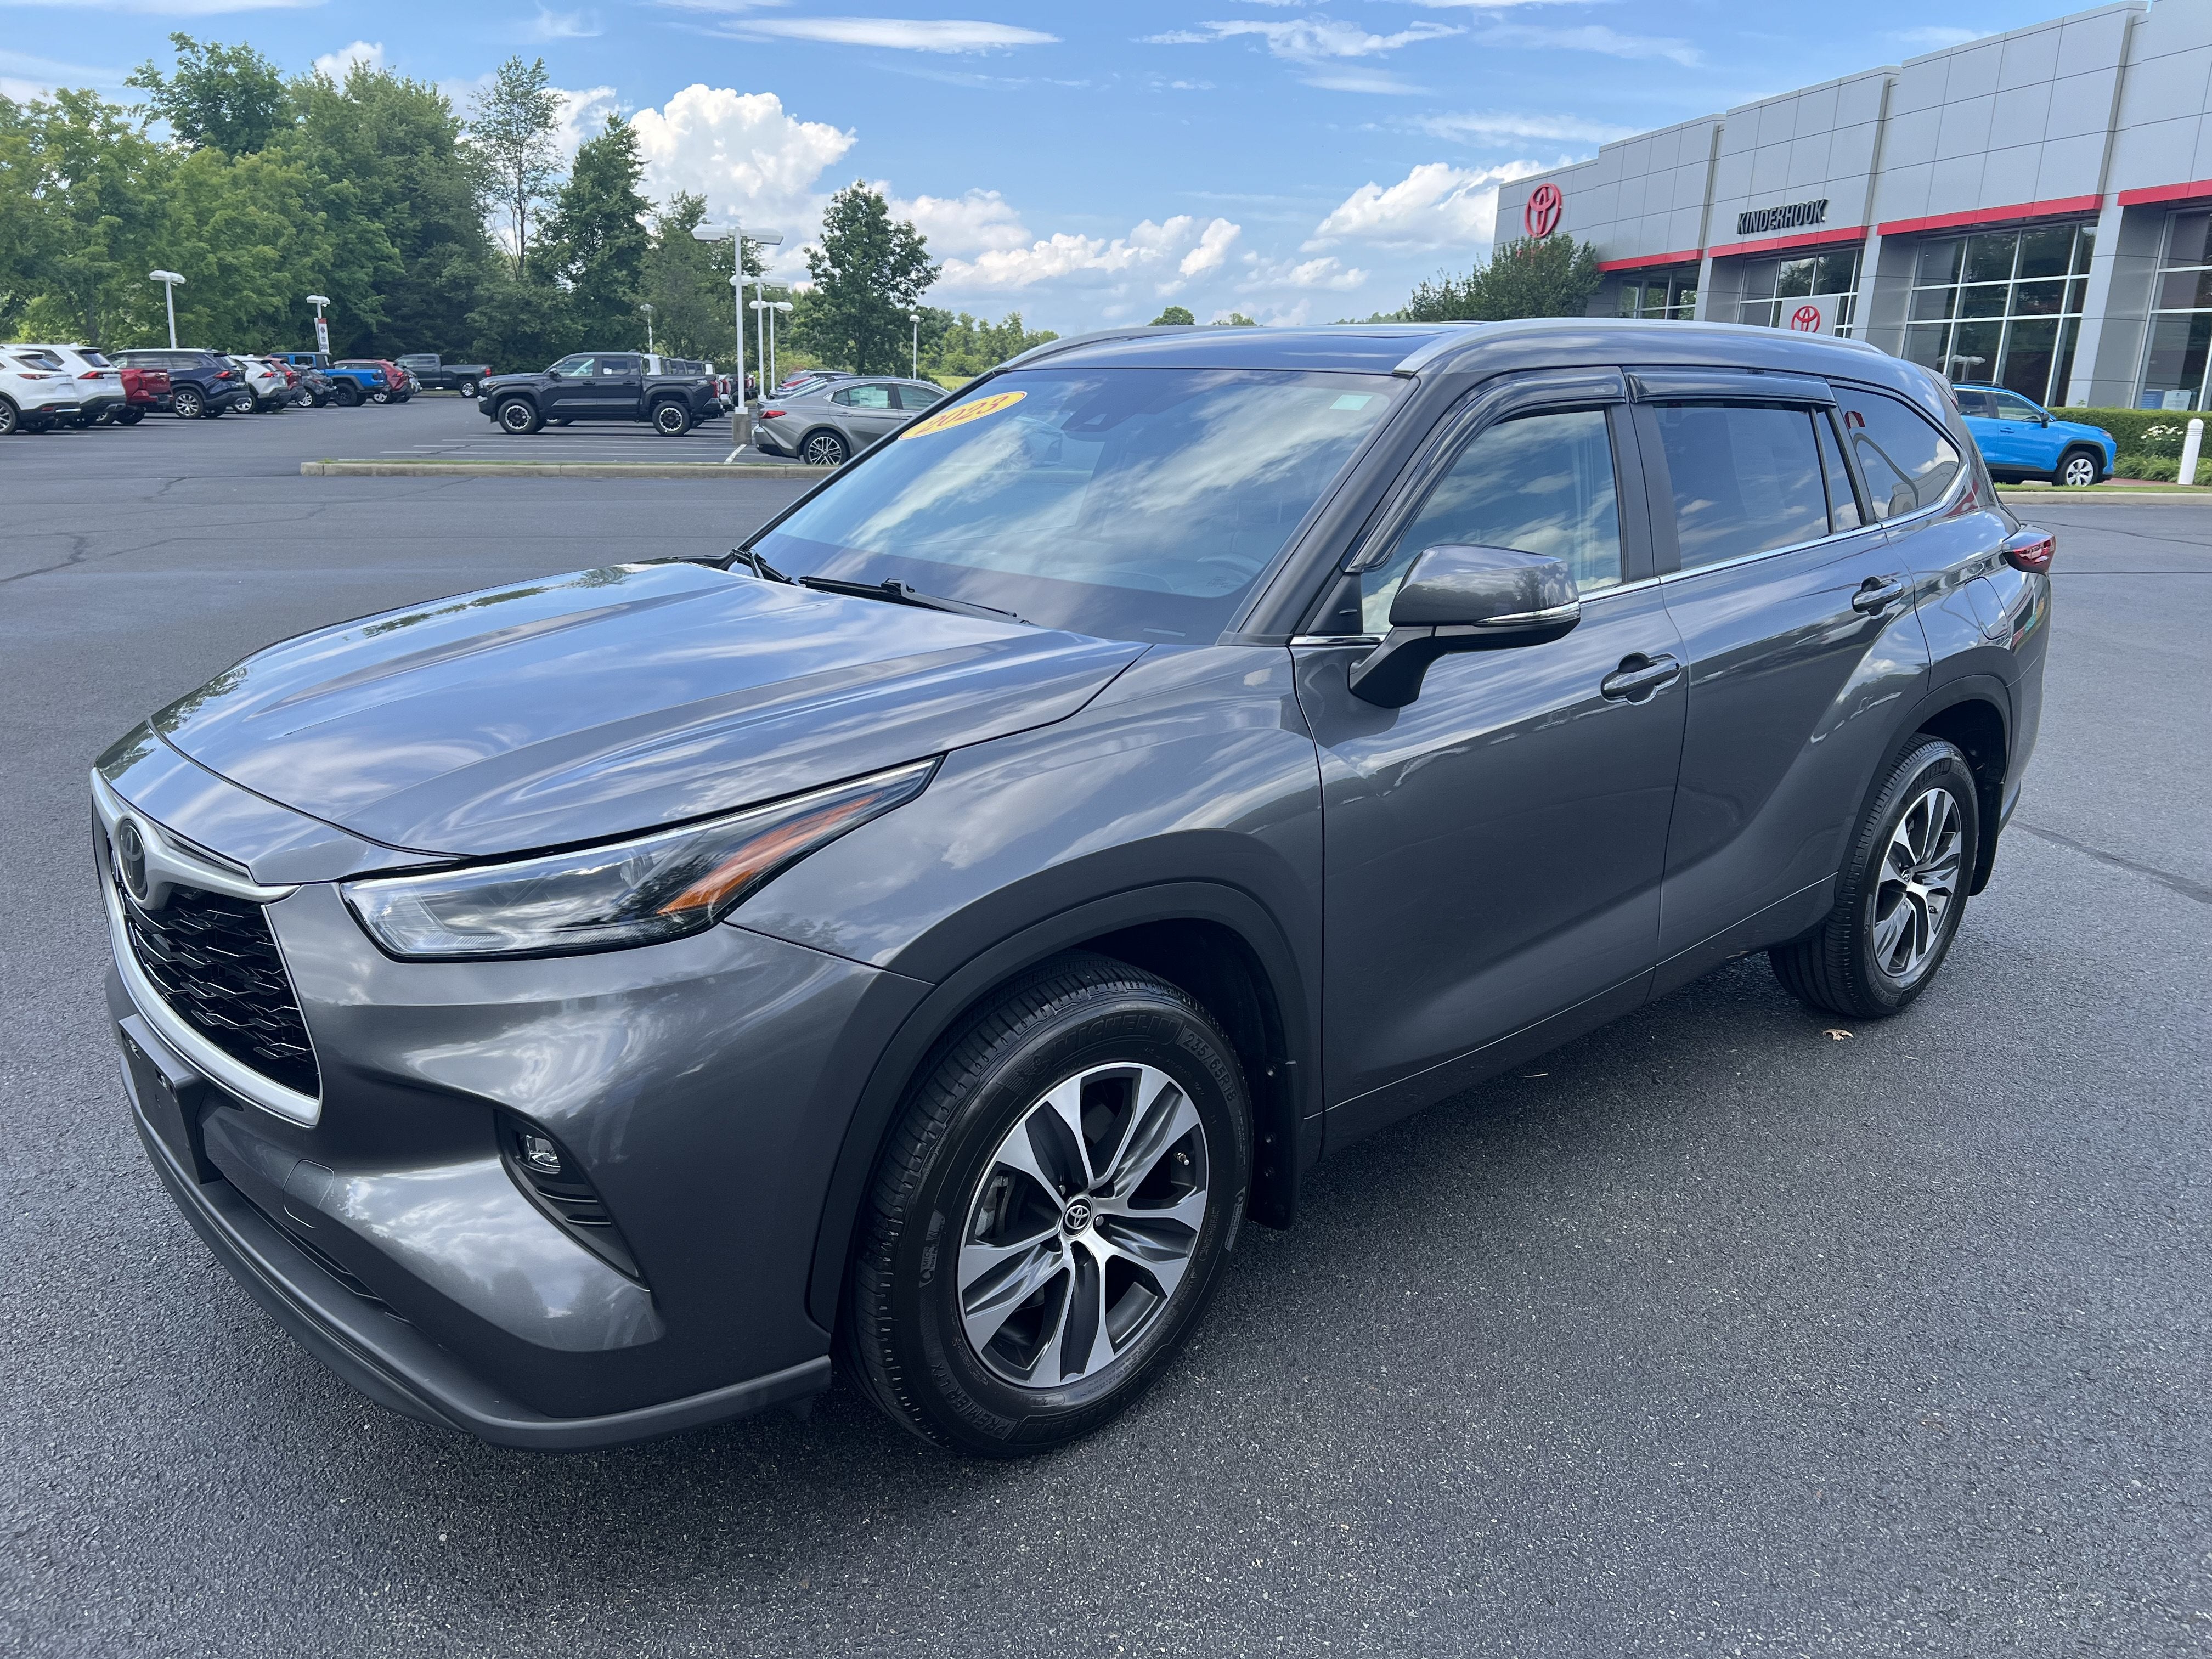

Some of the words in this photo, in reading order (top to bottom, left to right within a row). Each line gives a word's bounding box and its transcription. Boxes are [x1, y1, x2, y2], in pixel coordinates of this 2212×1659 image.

[1737, 199, 1828, 234] KINDERHOOK
[914, 396, 1009, 435] 2023
[1053, 1015, 1177, 1059] MICHELIN
[1183, 1033, 1237, 1101] 235/65R18
[931, 1361, 950, 1388] LTX
[945, 1386, 1011, 1434] PREMIER
